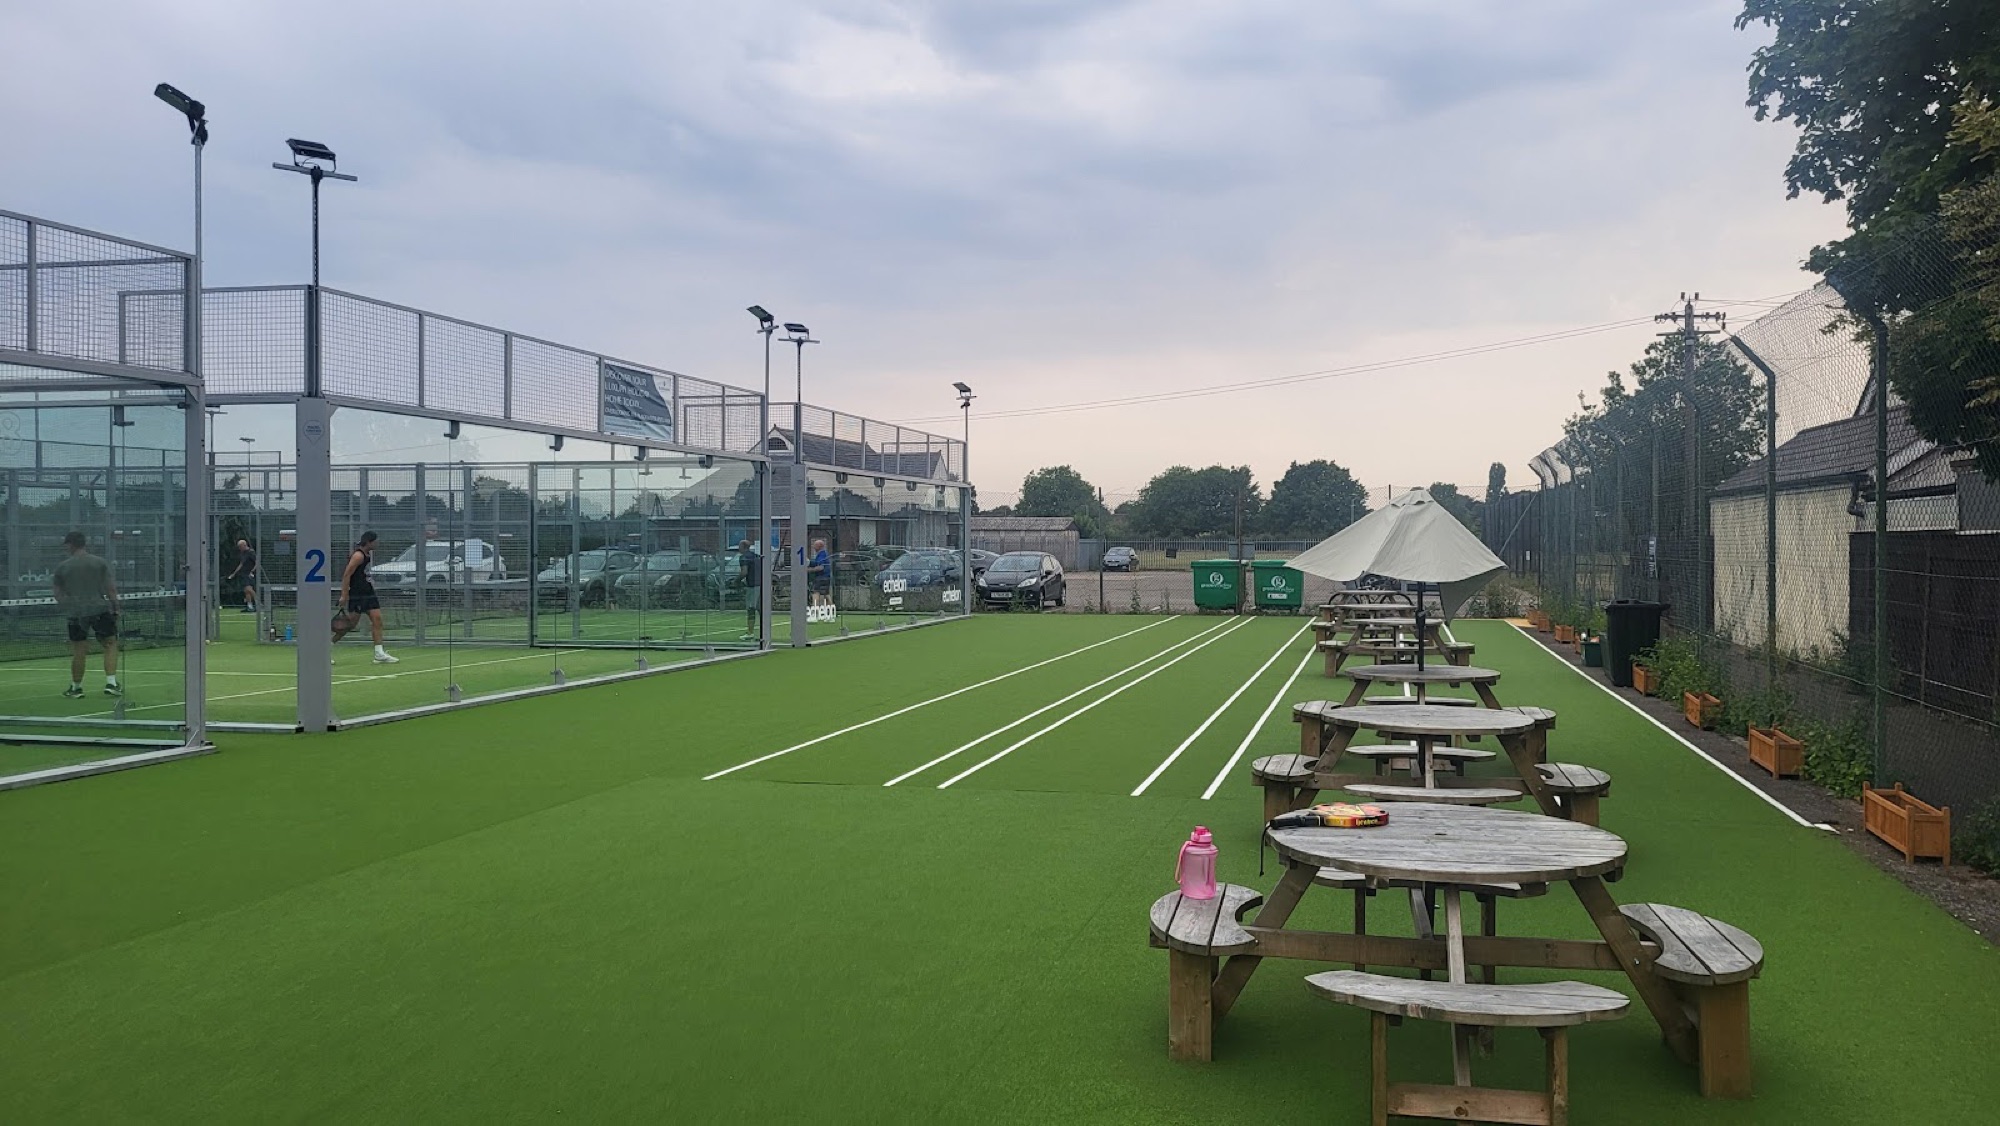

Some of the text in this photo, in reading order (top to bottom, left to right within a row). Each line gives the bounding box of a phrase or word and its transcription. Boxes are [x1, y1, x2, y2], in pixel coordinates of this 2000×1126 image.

[304, 549, 326, 583] 2
[797, 546, 804, 566] 1
[883, 573, 907, 593] echelon
